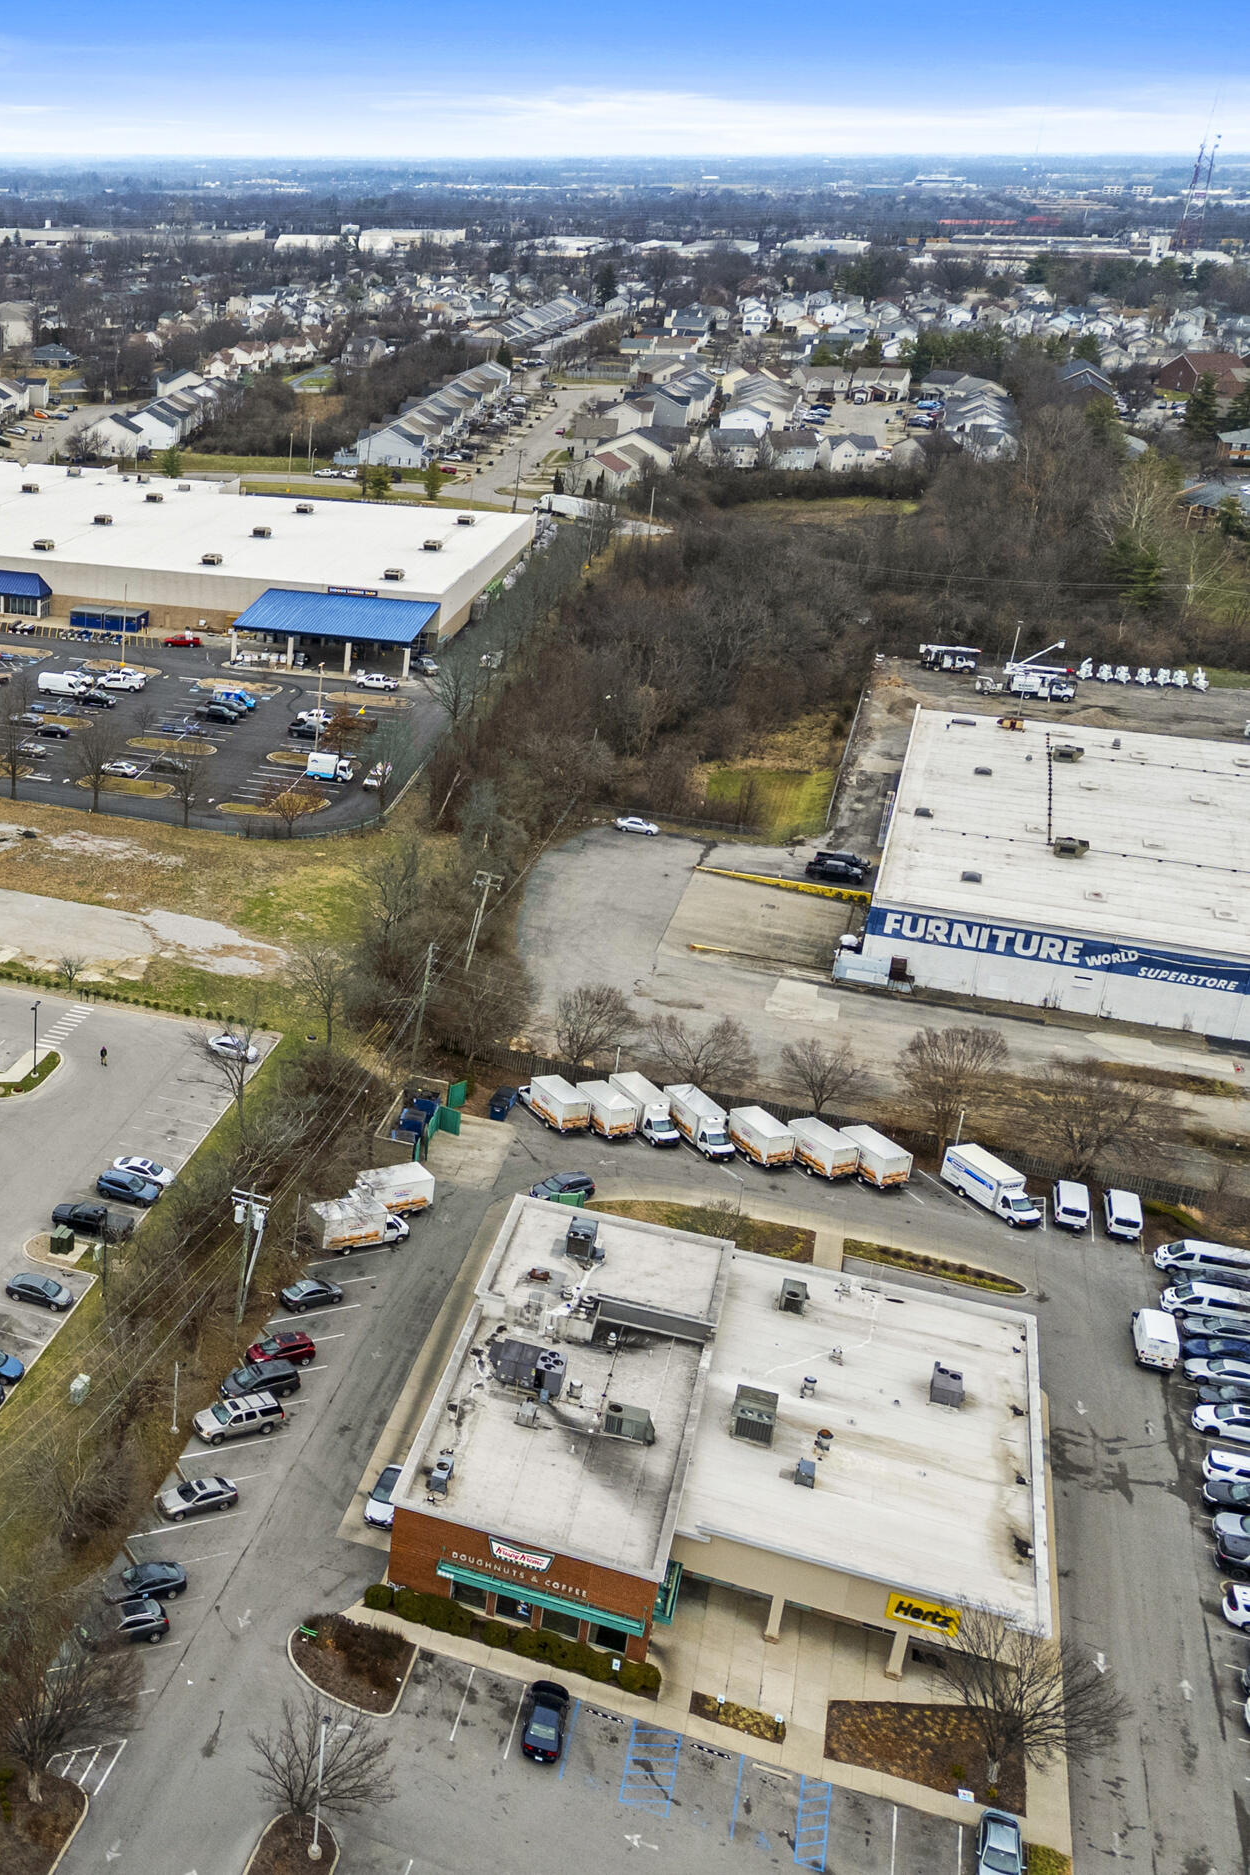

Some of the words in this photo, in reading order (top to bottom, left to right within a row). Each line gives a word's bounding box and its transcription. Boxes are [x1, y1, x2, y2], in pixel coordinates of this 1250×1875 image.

[883, 912, 1084, 964] FURNITURE
[1084, 950, 1139, 967] WORLD
[1137, 966, 1239, 991] SUPERSTORE
[451, 1551, 525, 1579] DOUGHNUTS
[530, 1575, 538, 1584] &
[544, 1579, 588, 1598] COFFEE
[894, 1600, 954, 1628] Hertz
